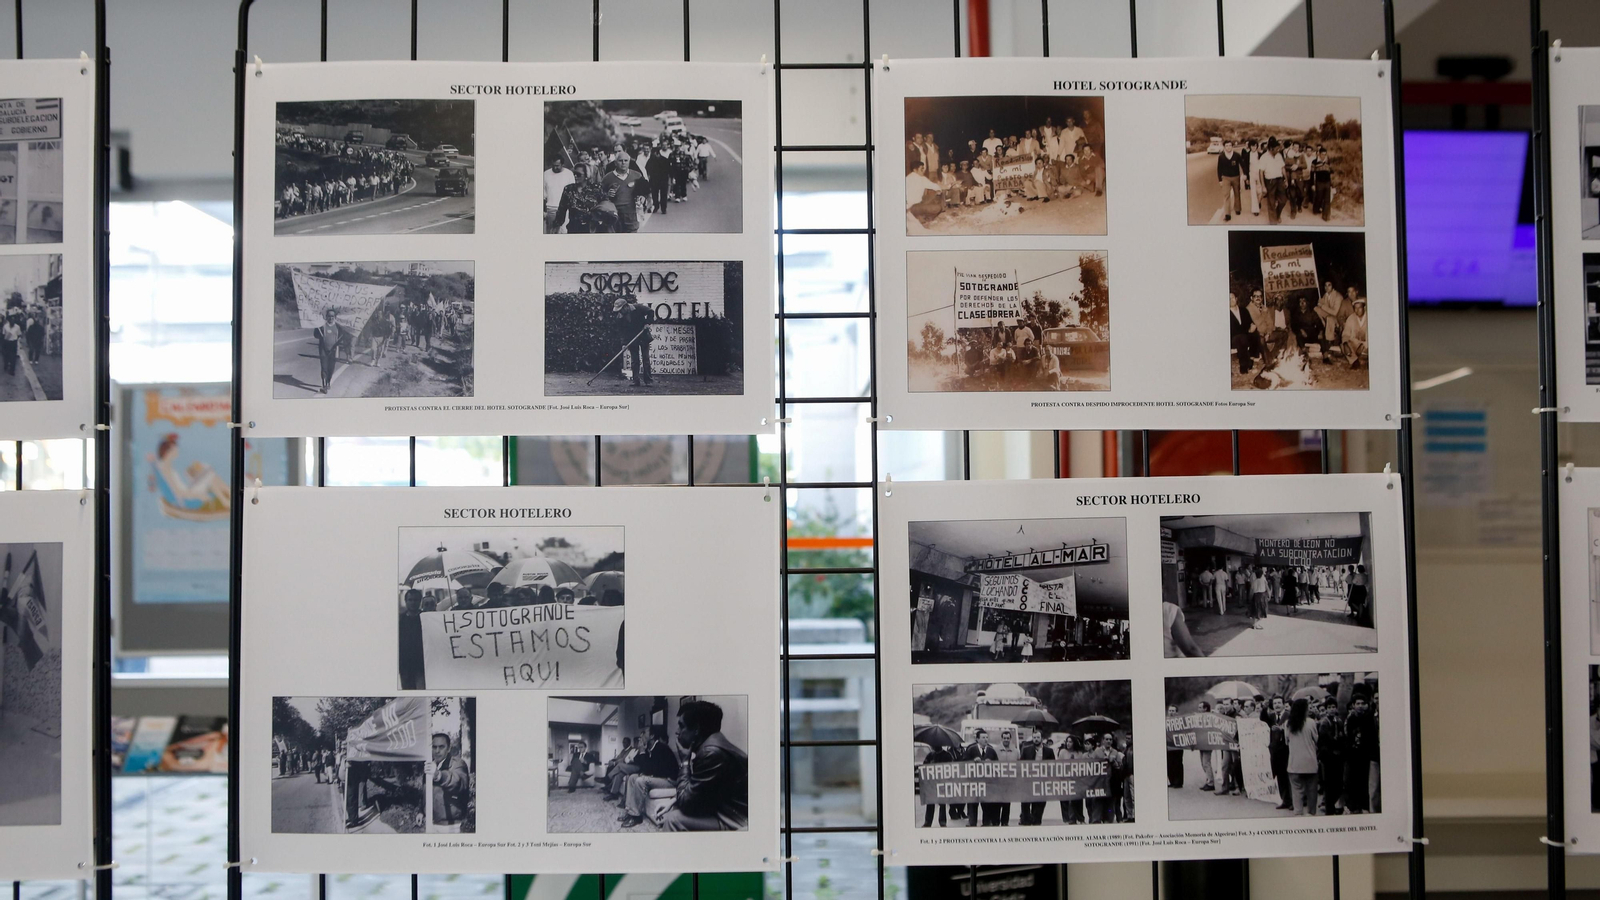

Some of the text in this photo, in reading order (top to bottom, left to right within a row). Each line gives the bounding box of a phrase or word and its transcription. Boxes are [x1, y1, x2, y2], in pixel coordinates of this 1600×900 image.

[450, 85, 576, 95] SECTOR HOTELERO
[1053, 80, 1188, 90] HOTEL SOTOGRANDE
[11, 125, 48, 134] GOBIERNO
[1288, 258, 1302, 268] mi
[1268, 270, 1315, 280] PUESTO DE
[1268, 278, 1316, 291] TRABAJO
[673, 326, 694, 335] MESES
[1076, 493, 1201, 506] SECTOR HOTELERO
[443, 508, 572, 519] SECTOR HOTELERO
[1259, 538, 1336, 549] MONTERO DE LEON NO
[977, 546, 1106, 570] HOTEL AL-MAR
[1267, 548, 1276, 557] LA
[1279, 548, 1353, 559] SUBCONTRATACION
[984, 574, 1020, 587] SEGUIMOS
[1040, 601, 1069, 615] FINAL
[449, 626, 591, 659] ESTAMOS
[918, 762, 1017, 781] TRABAJADORES
[936, 782, 987, 798] CONTRA
[1032, 780, 1077, 797] CIERRE
